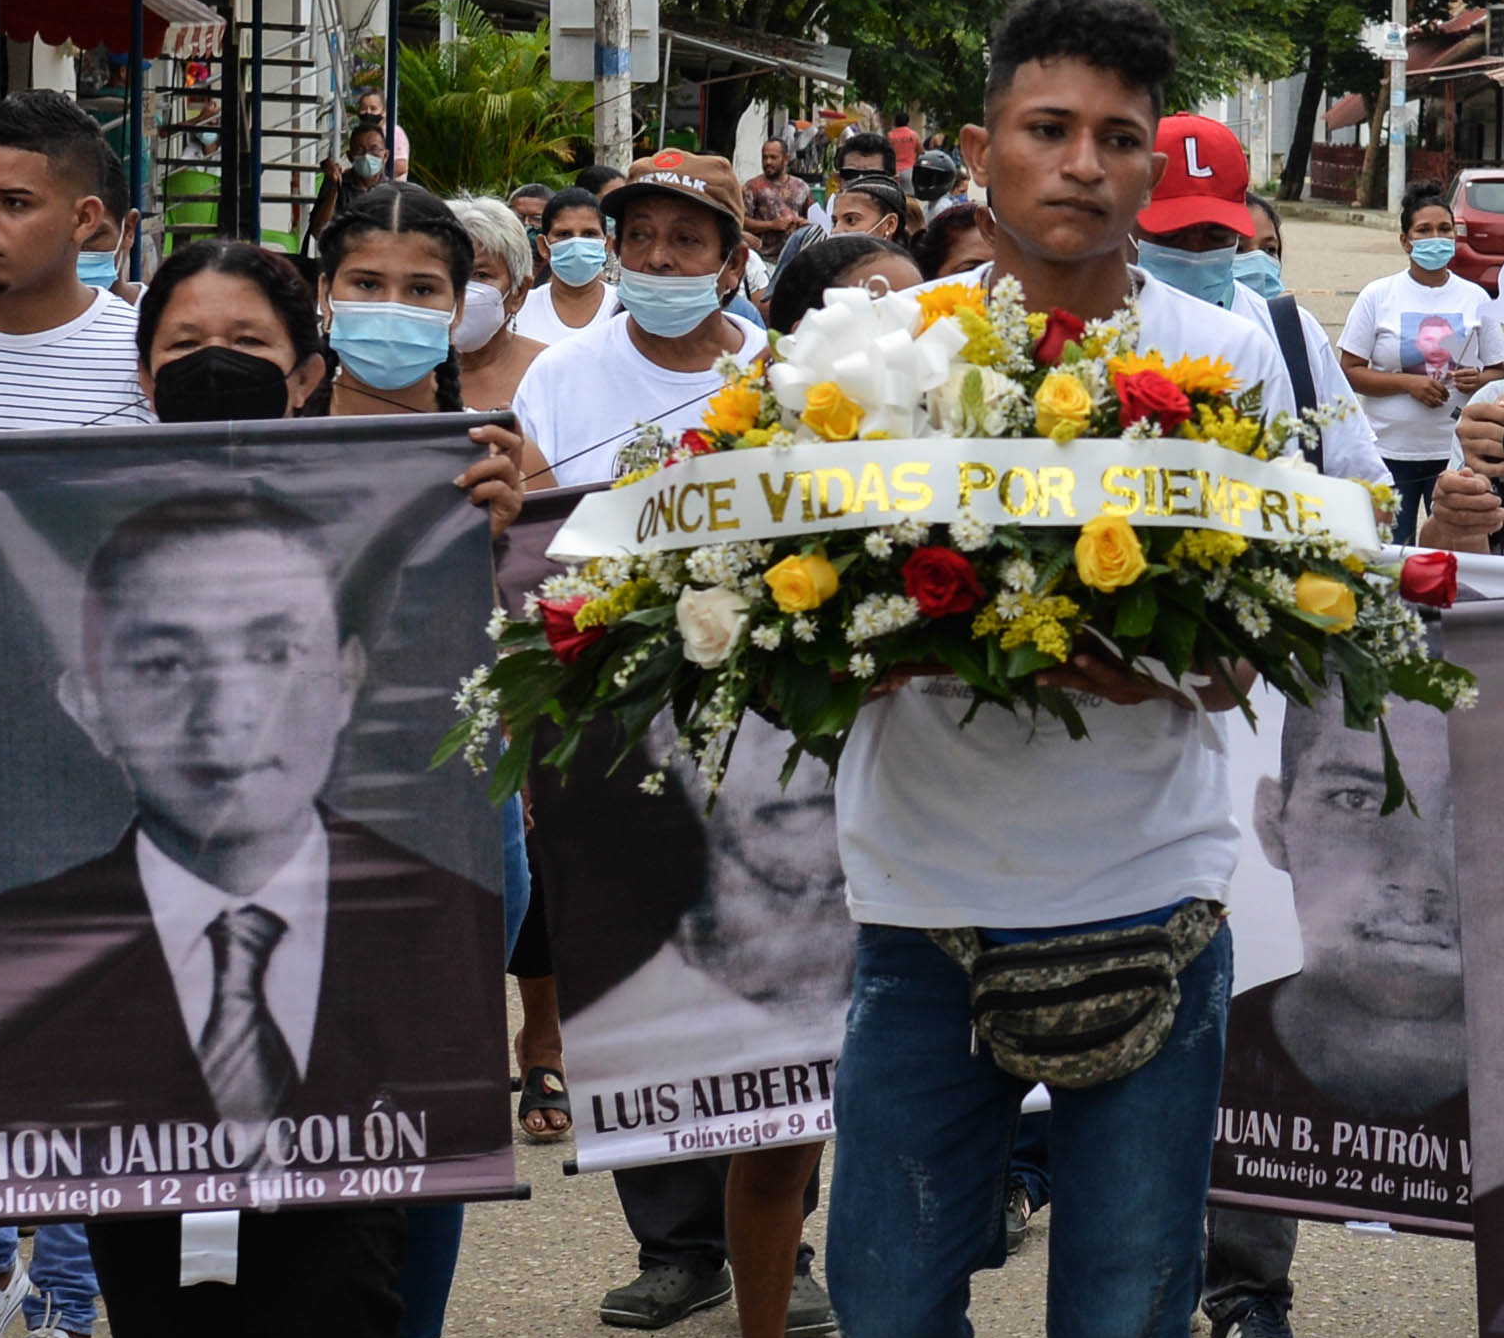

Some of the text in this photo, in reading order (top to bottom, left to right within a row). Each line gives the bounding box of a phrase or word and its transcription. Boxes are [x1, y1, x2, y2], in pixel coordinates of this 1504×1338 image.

[1183, 136, 1215, 179] L
[636, 460, 1331, 543] ONCE VIDAS POR SIEMPRE
[592, 1058, 836, 1134] LUIS ALBERT
[100, 1119, 246, 1175] JAIRO
[265, 1101, 427, 1167] COLÓN
[663, 1108, 836, 1153] Tolúviejo 9 d
[1213, 1107, 1282, 1149] JUAN
[1292, 1115, 1320, 1154] B.
[1331, 1121, 1450, 1172] PATRÓN
[136, 1179, 182, 1206] 12
[196, 1174, 237, 1204] de
[247, 1169, 327, 1208] julio
[339, 1164, 426, 1198] 2007
[1234, 1153, 1328, 1189] Tolúviejo
[1335, 1167, 1363, 1191] 22
[1371, 1172, 1396, 1195] de
[1401, 1176, 1449, 1203] julio
